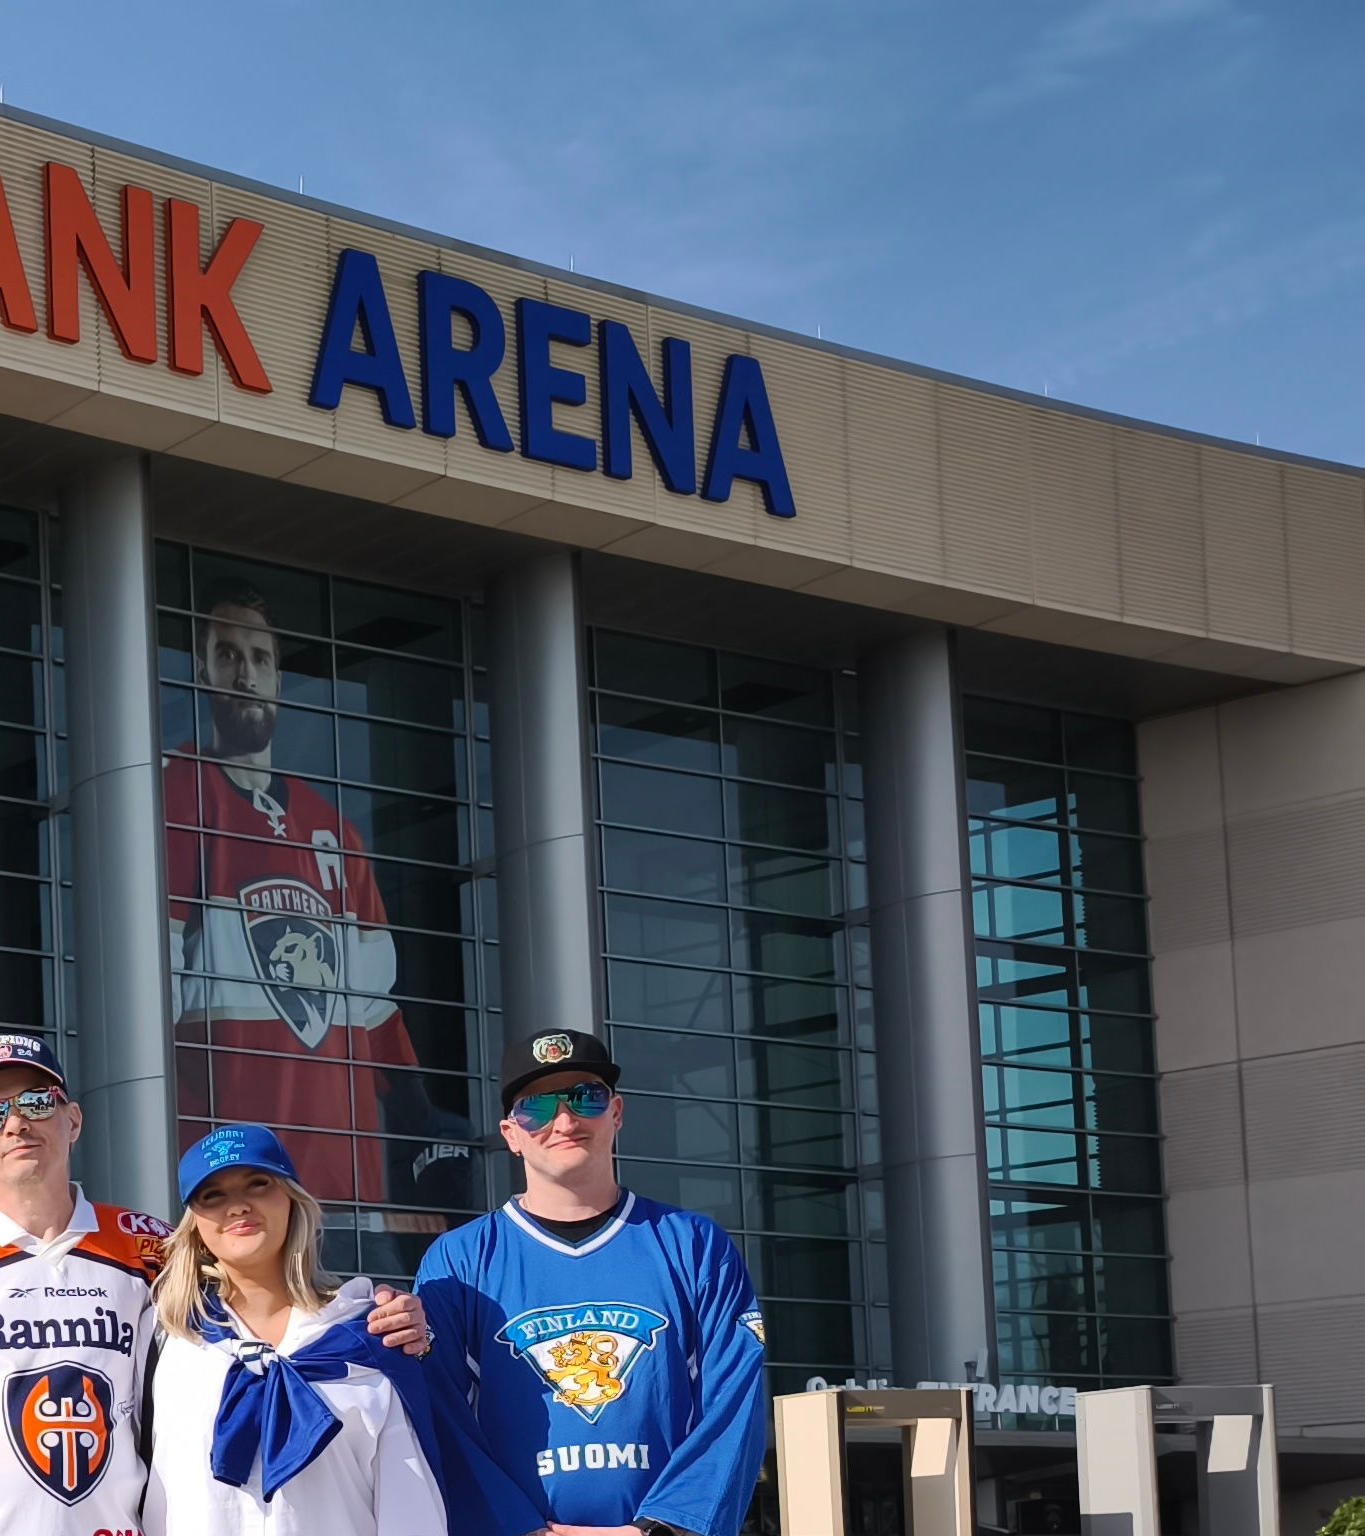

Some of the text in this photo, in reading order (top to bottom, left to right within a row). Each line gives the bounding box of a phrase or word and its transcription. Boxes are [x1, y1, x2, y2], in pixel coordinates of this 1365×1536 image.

[308, 248, 797, 518] ARENA
[251, 887, 326, 918] PANTHERS
[44, 1287, 108, 1298] Reebok
[517, 1309, 640, 1340] FINLAND
[536, 1443, 650, 1477] SUOMI
